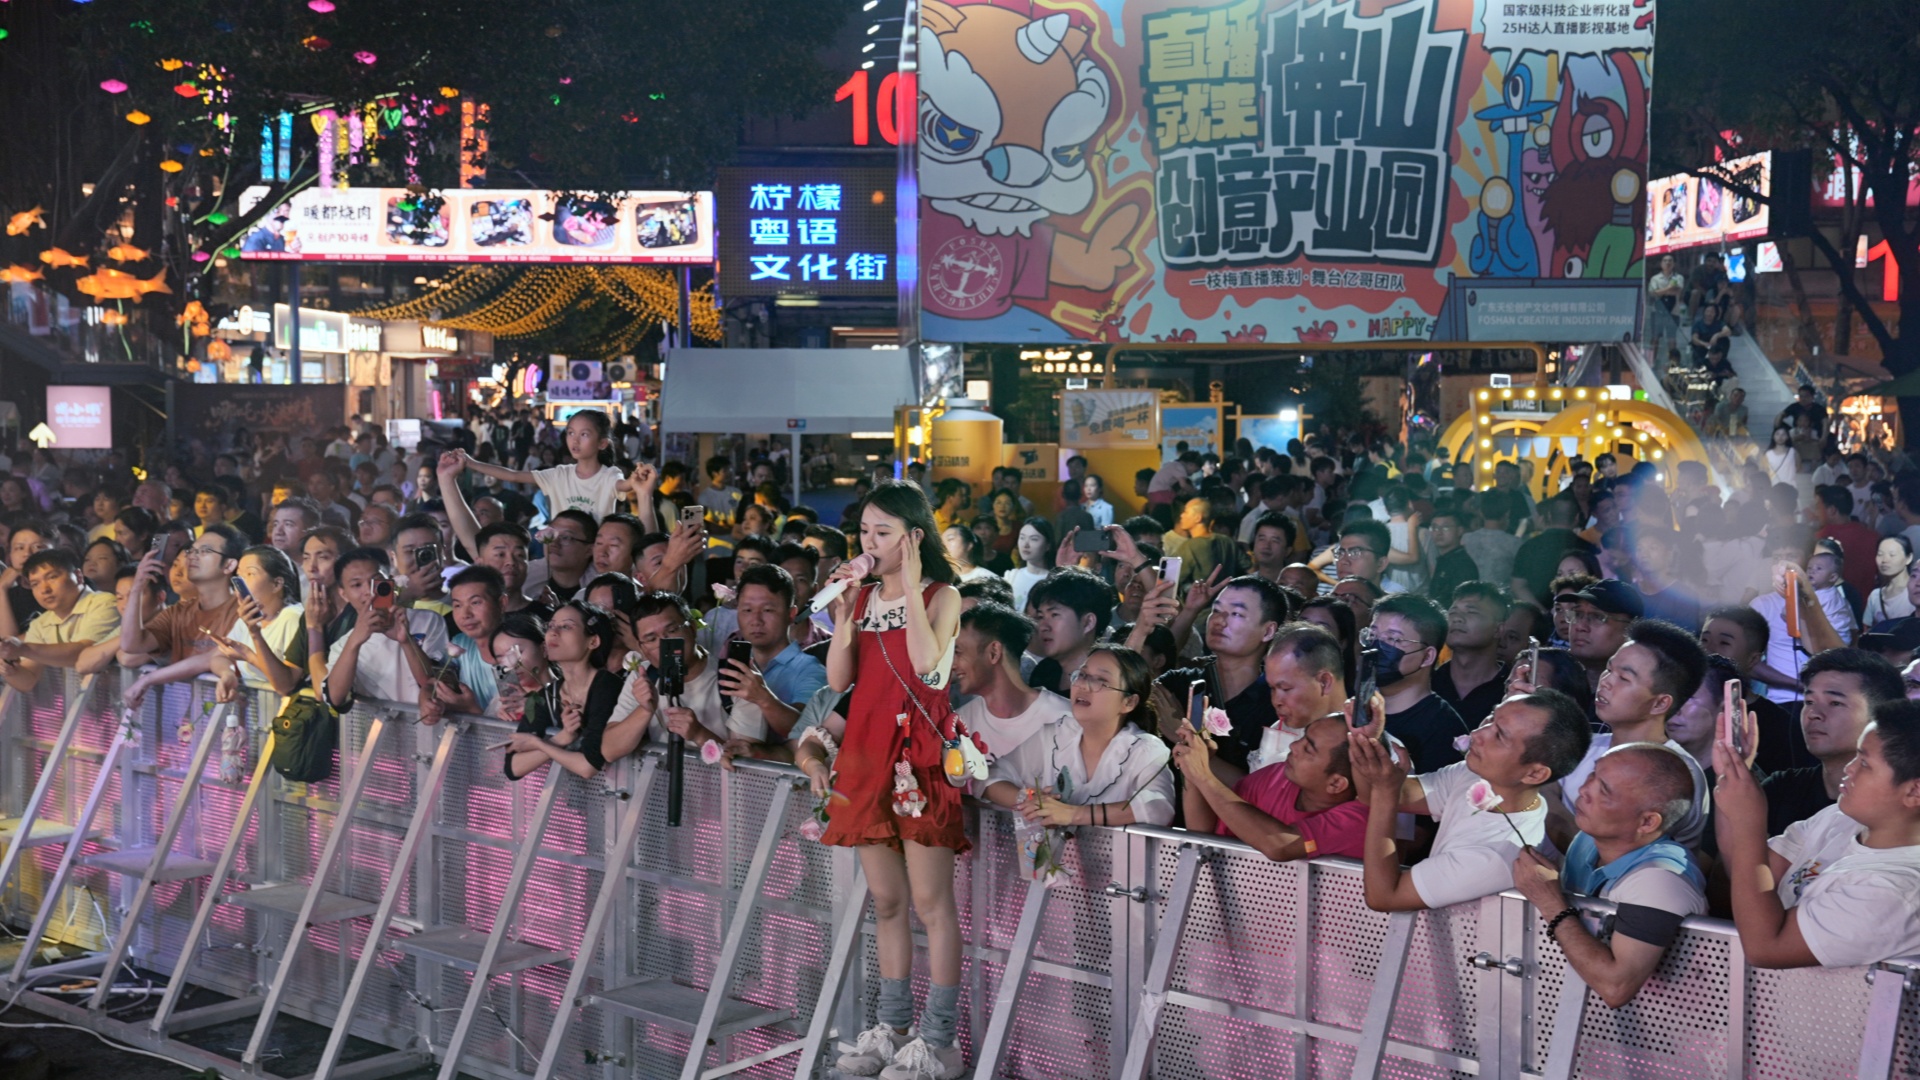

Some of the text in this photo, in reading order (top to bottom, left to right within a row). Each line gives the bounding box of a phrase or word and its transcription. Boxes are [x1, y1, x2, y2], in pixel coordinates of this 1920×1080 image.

[1503, 4, 1630, 17] 国家级科技企业孵化器
[1502, 21, 1630, 35] 25H达人直播影视基地
[1148, 0, 1259, 82] 直播
[1153, 82, 1258, 150] 就来
[750, 184, 841, 211] 柠檬
[1159, 147, 1440, 257] 创意产业园
[303, 206, 371, 221] 暖都烧肉
[750, 218, 837, 245] 粤语
[750, 253, 887, 281] 文化街
[1191, 269, 1406, 291] 一枝梅直播策划·舞台亿哥团队
[1368, 317, 1427, 338] HAPPY
[1478, 315, 1634, 326] FOSHAN CREATIVE INDUSTRY PARK
